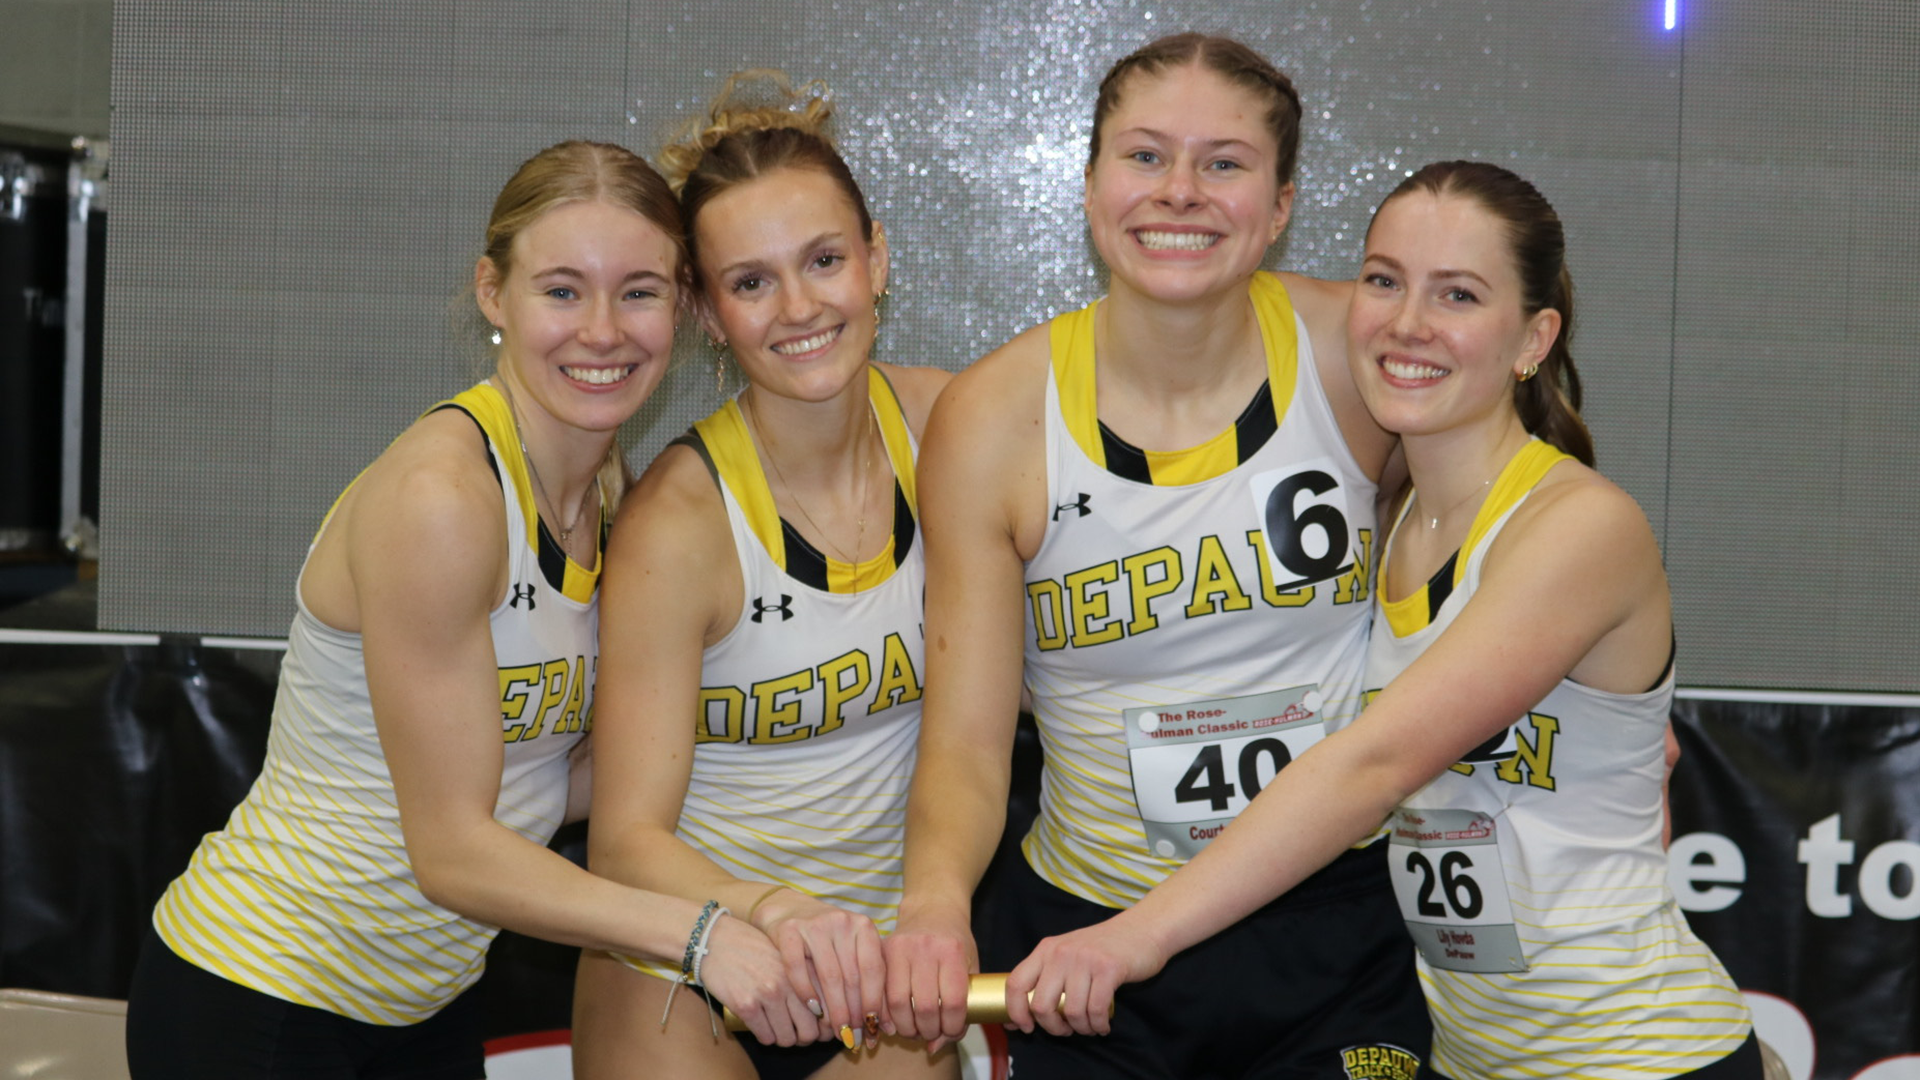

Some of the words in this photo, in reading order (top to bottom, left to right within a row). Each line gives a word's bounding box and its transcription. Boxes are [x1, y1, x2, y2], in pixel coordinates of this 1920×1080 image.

[1265, 470, 1349, 579] 6
[696, 632, 924, 745] DEPA
[1157, 712, 1183, 723] The
[1186, 708, 1227, 720] Rose-
[1142, 728, 1194, 739] ulman
[1197, 720, 1249, 735] Classic
[1174, 737, 1292, 812] 40
[1406, 851, 1483, 919] 26
[1797, 813, 1920, 920] to
